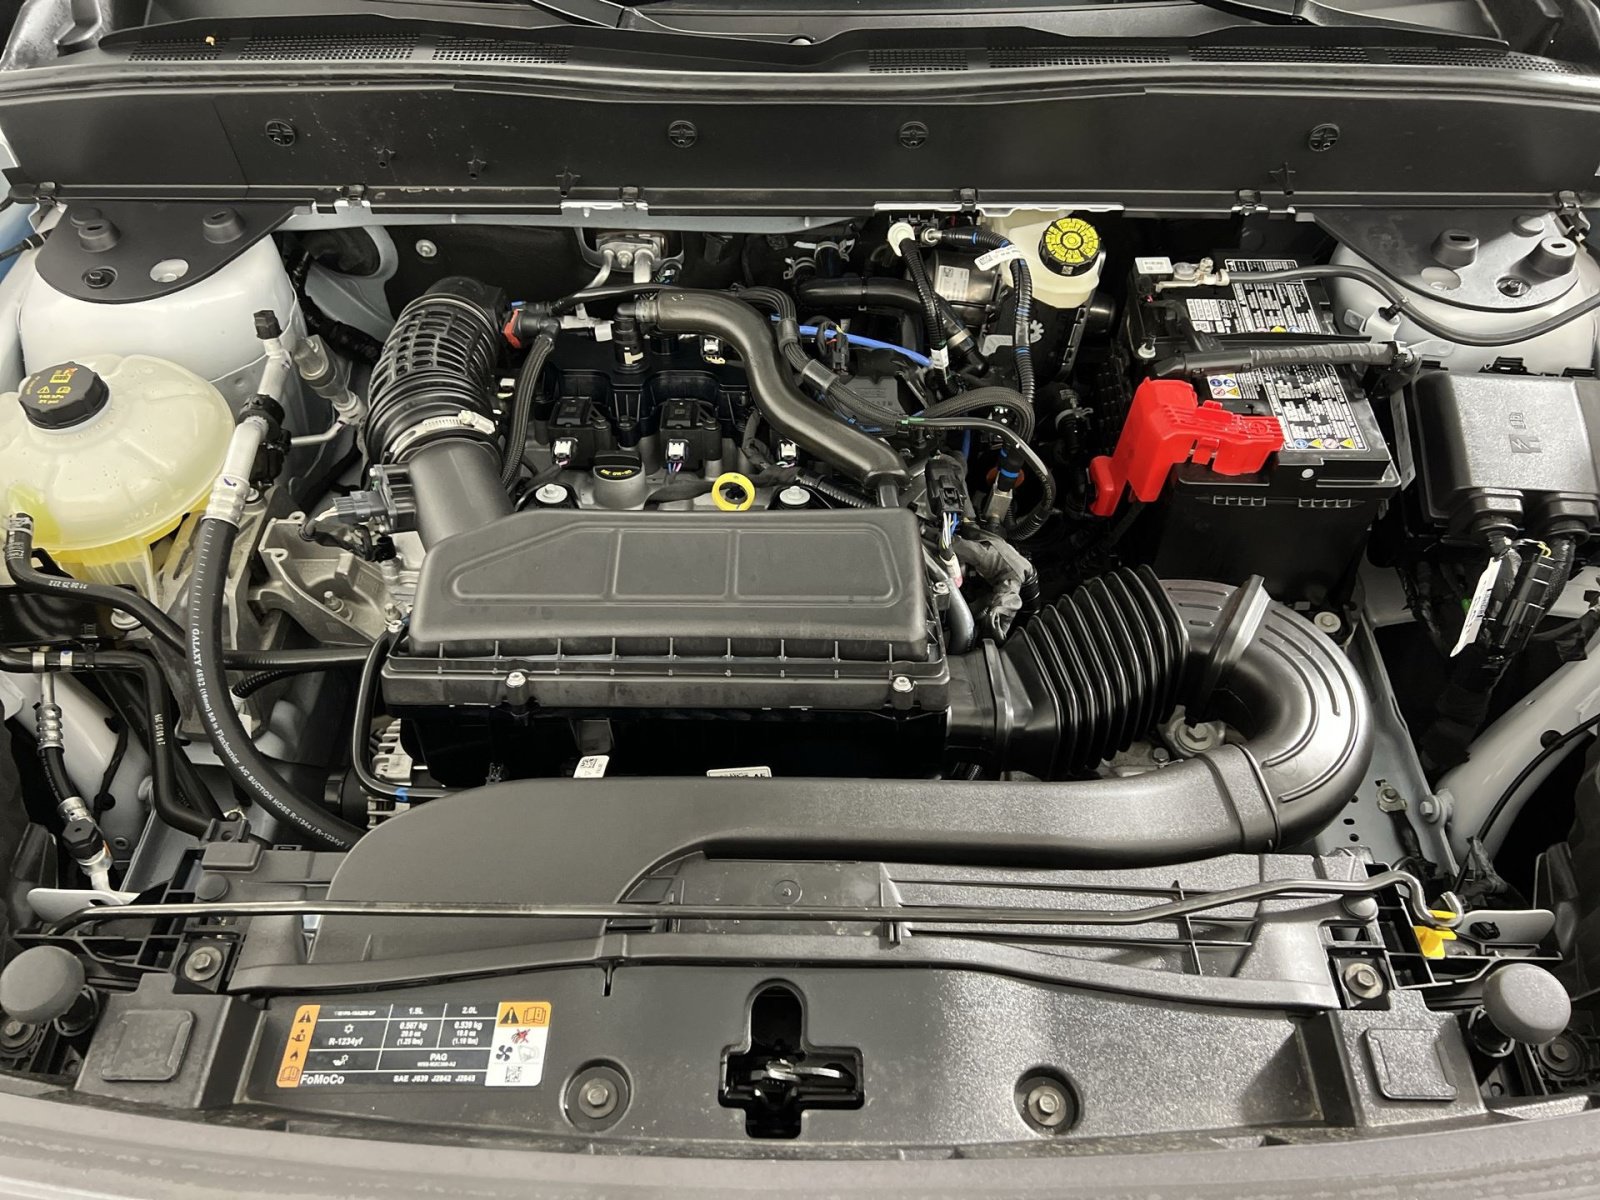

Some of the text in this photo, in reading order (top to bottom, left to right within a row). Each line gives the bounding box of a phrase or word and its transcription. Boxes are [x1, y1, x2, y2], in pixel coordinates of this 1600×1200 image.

[192, 628, 202, 667] GALAXY
[200, 688, 212, 712] (16mm)
[239, 765, 250, 777] A/C
[248, 775, 274, 801] SUCTION
[272, 799, 291, 815] HOSE
[290, 812, 312, 830] R-134a
[316, 828, 345, 847] R-1234yf
[408, 1007, 424, 1015] 1.5L
[461, 1006, 478, 1014] 2.0L
[418, 1022, 428, 1031] kg
[473, 1021, 483, 1031] kg
[328, 1036, 364, 1047] R-1234yf
[429, 1053, 448, 1061] PAG
[300, 1073, 345, 1085] FoMoCo
